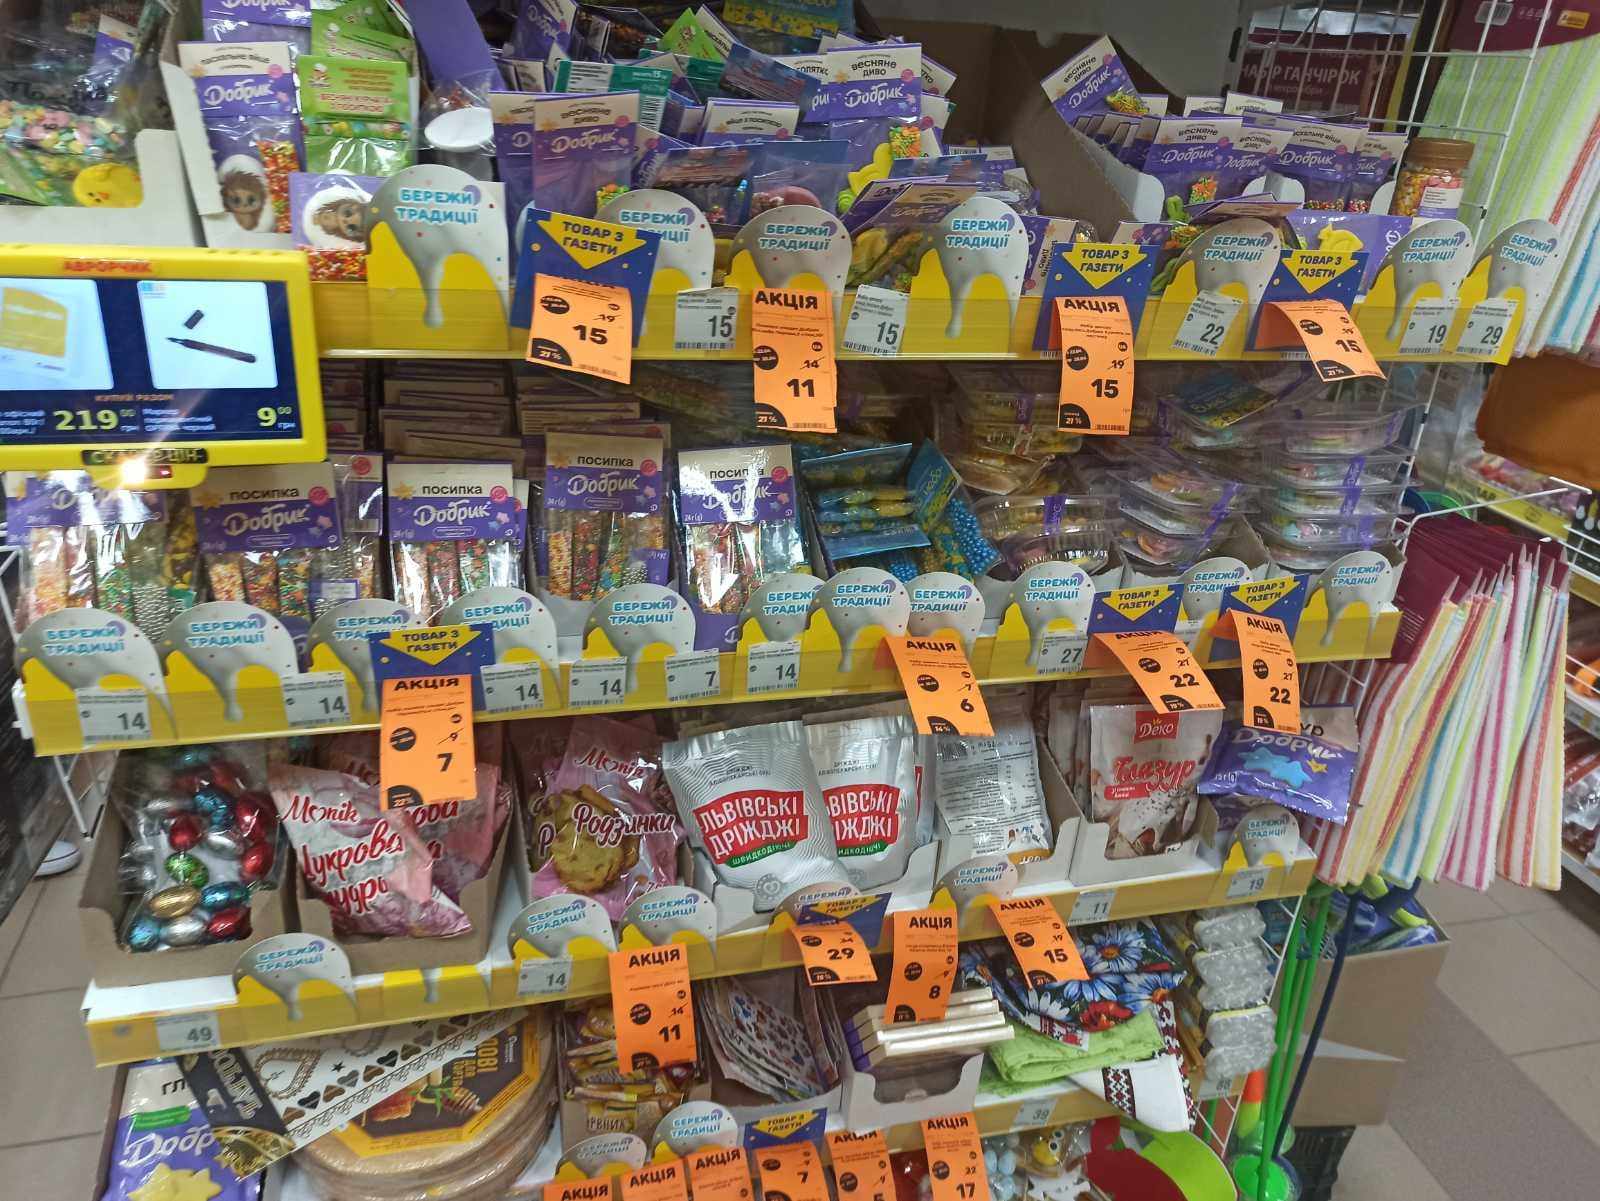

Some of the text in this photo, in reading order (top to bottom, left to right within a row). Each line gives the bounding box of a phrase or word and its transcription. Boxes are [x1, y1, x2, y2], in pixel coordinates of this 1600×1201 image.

[852, 59, 896, 72] весняне
[863, 68, 887, 78] диво
[1064, 56, 1097, 84] весняне
[1074, 66, 1092, 82] диво
[204, 79, 275, 106] Добрик
[845, 83, 904, 109] Добрик
[1068, 68, 1112, 108] Добрик
[1178, 128, 1218, 138] весняне
[552, 129, 617, 154] Добрик
[1161, 147, 1216, 164] Добрик
[1280, 149, 1336, 166] Добрик
[400, 188, 473, 205] БЕРЕЖИ
[395, 206, 478, 225] ТРАДИЦІЇ
[621, 211, 687, 225] БЕРЕЖИ
[563, 221, 612, 240] ТОВАР
[766, 224, 829, 238] БЕРЕЖИ
[952, 219, 1008, 234] БЕРЕЖИ
[563, 236, 618, 256] ГАЗЕТИ
[759, 236, 831, 251] ТРАДИЦІЇ
[947, 234, 1008, 251] ТРАДИЦІЇ
[1213, 236, 1267, 248] БЕРЕЖИ
[1411, 237, 1459, 250] БЕРЕЖИ
[1511, 234, 1552, 251] БЕРЕЖИ
[1080, 248, 1119, 260] ТОВАР
[1204, 248, 1263, 262] ТРАДИЦІЇ
[1299, 254, 1334, 267] ТОВАР
[1403, 249, 1456, 264] ТРАДИЦІЇ
[1502, 246, 1545, 266] ТРАДИЦІЇ
[1080, 260, 1124, 273] ГАЗЕТИ
[1296, 267, 1337, 279] ГАЗЕТИ
[755, 291, 819, 311] АКЦІЯ
[1063, 299, 1120, 314] АКЦІЯ
[708, 314, 733, 338] 15
[877, 321, 899, 346] 15
[1200, 322, 1225, 346] 22
[1428, 324, 1447, 344] 19
[573, 324, 609, 345] 15
[1480, 325, 1504, 345] 29
[1335, 339, 1362, 354] 15
[786, 378, 815, 398] 11
[1091, 378, 1119, 399] 15
[53, 408, 118, 431] 219
[257, 406, 277, 427] 9
[577, 455, 634, 468] посипка
[422, 484, 482, 498] посипка
[567, 471, 638, 496] Добрик
[230, 488, 299, 501] посипка
[223, 503, 310, 537] Добрик
[413, 500, 491, 528] Добрик
[1194, 570, 1240, 582] БЕРЕЖИ
[1338, 564, 1379, 576] БЕРЕЖИ
[837, 582, 891, 595] БЕРЕЖИ
[1030, 576, 1077, 589] БЕРЕЖИ
[1246, 583, 1278, 594] ТОВАР
[1332, 574, 1378, 587] ТРАДИЦІЇ
[832, 595, 891, 609] ТРАДИЦІЇ
[914, 588, 966, 600] БЕРЕЖИ
[1025, 588, 1080, 602] ТРАДИЦІЇ
[1118, 591, 1151, 601] ТОВАР
[1246, 591, 1282, 602] ГАЗЕТИ
[464, 602, 525, 618] БЕРЕЖИ
[613, 599, 672, 613] БЕРЕЖИ
[910, 600, 967, 613] ТРАДИЦІЇ
[1117, 600, 1156, 610] ГАЗЕТИ
[191, 617, 259, 633] БЕРЕЖИ
[337, 614, 402, 628] БЕРЕЖИ
[608, 611, 673, 626] ТРАДИЦІЇ
[1247, 616, 1282, 635] АКЦІЯ
[48, 626, 118, 641] БЕРЕЖИ
[188, 631, 264, 647] ТРАДИЦІЇ
[402, 631, 449, 644] ТОВАР
[45, 639, 125, 656] ТРАДИЦІЇ
[406, 640, 458, 653] ГАЗЕТИ
[906, 640, 957, 653] АКЦІЯ
[1060, 648, 1083, 664] 27
[705, 670, 717, 687] 7
[775, 663, 797, 680] 14
[394, 678, 460, 693] АКЦІЯ
[599, 679, 622, 696] 14
[1169, 674, 1200, 688] 22
[515, 684, 539, 701] 14
[1269, 686, 1291, 705] 22
[318, 695, 346, 716] 14
[960, 698, 975, 713] 6
[117, 712, 146, 731] 14
[1138, 719, 1175, 736] Деко
[436, 753, 453, 771] 7
[1112, 754, 1196, 795] Глазур
[700, 794, 797, 834] ЛЬВІВСЬКІ
[572, 802, 675, 848] Родзинки
[835, 814, 892, 842] ІЖДЖІ
[1249, 818, 1287, 830] БЕРЕЖИ
[708, 817, 800, 859] ДРІЖДЖІ
[1247, 828, 1286, 840] ТРАДИЦІЇ
[731, 842, 792, 866] ШВИДКОДІЮЧІ
[959, 864, 1007, 877] БЕРЕЖИ
[954, 873, 1003, 888] ТРАДИЦІЇ
[1249, 877, 1265, 891] 19
[640, 898, 695, 911] БЕРЕЖИ
[1000, 897, 1046, 912] АКЦІЯ
[1085, 899, 1109, 915] 11
[528, 902, 581, 925] БЕРЕЖИ
[640, 907, 697, 922] ТРАДИЦІЇ
[528, 912, 586, 934] ТРАДИЦІЇ
[909, 916, 952, 931] АКЦІЯ
[629, 948, 681, 968] АКЦІЯ
[826, 947, 855, 961] 29
[1044, 948, 1068, 964] 15
[254, 953, 323, 973] ТРАДИЦІЇ
[547, 972, 566, 987] 14
[928, 985, 941, 999] 8
[187, 1026, 213, 1042] 49
[659, 1023, 681, 1043] 11
[672, 1112, 720, 1128] БЕРЕЖИ
[1032, 1108, 1051, 1121] 39
[671, 1122, 721, 1138] ТРАДИЦІЇ
[926, 1115, 969, 1131] АКЦІЯ
[118, 1124, 214, 1167] Добр
[695, 1148, 741, 1171] АКЦІЯ
[629, 1166, 676, 1189] АКЦІЯ
[797, 1172, 808, 1185] 7
[562, 1184, 609, 1201] АКЦІЯ
[956, 1182, 976, 1200] 17
